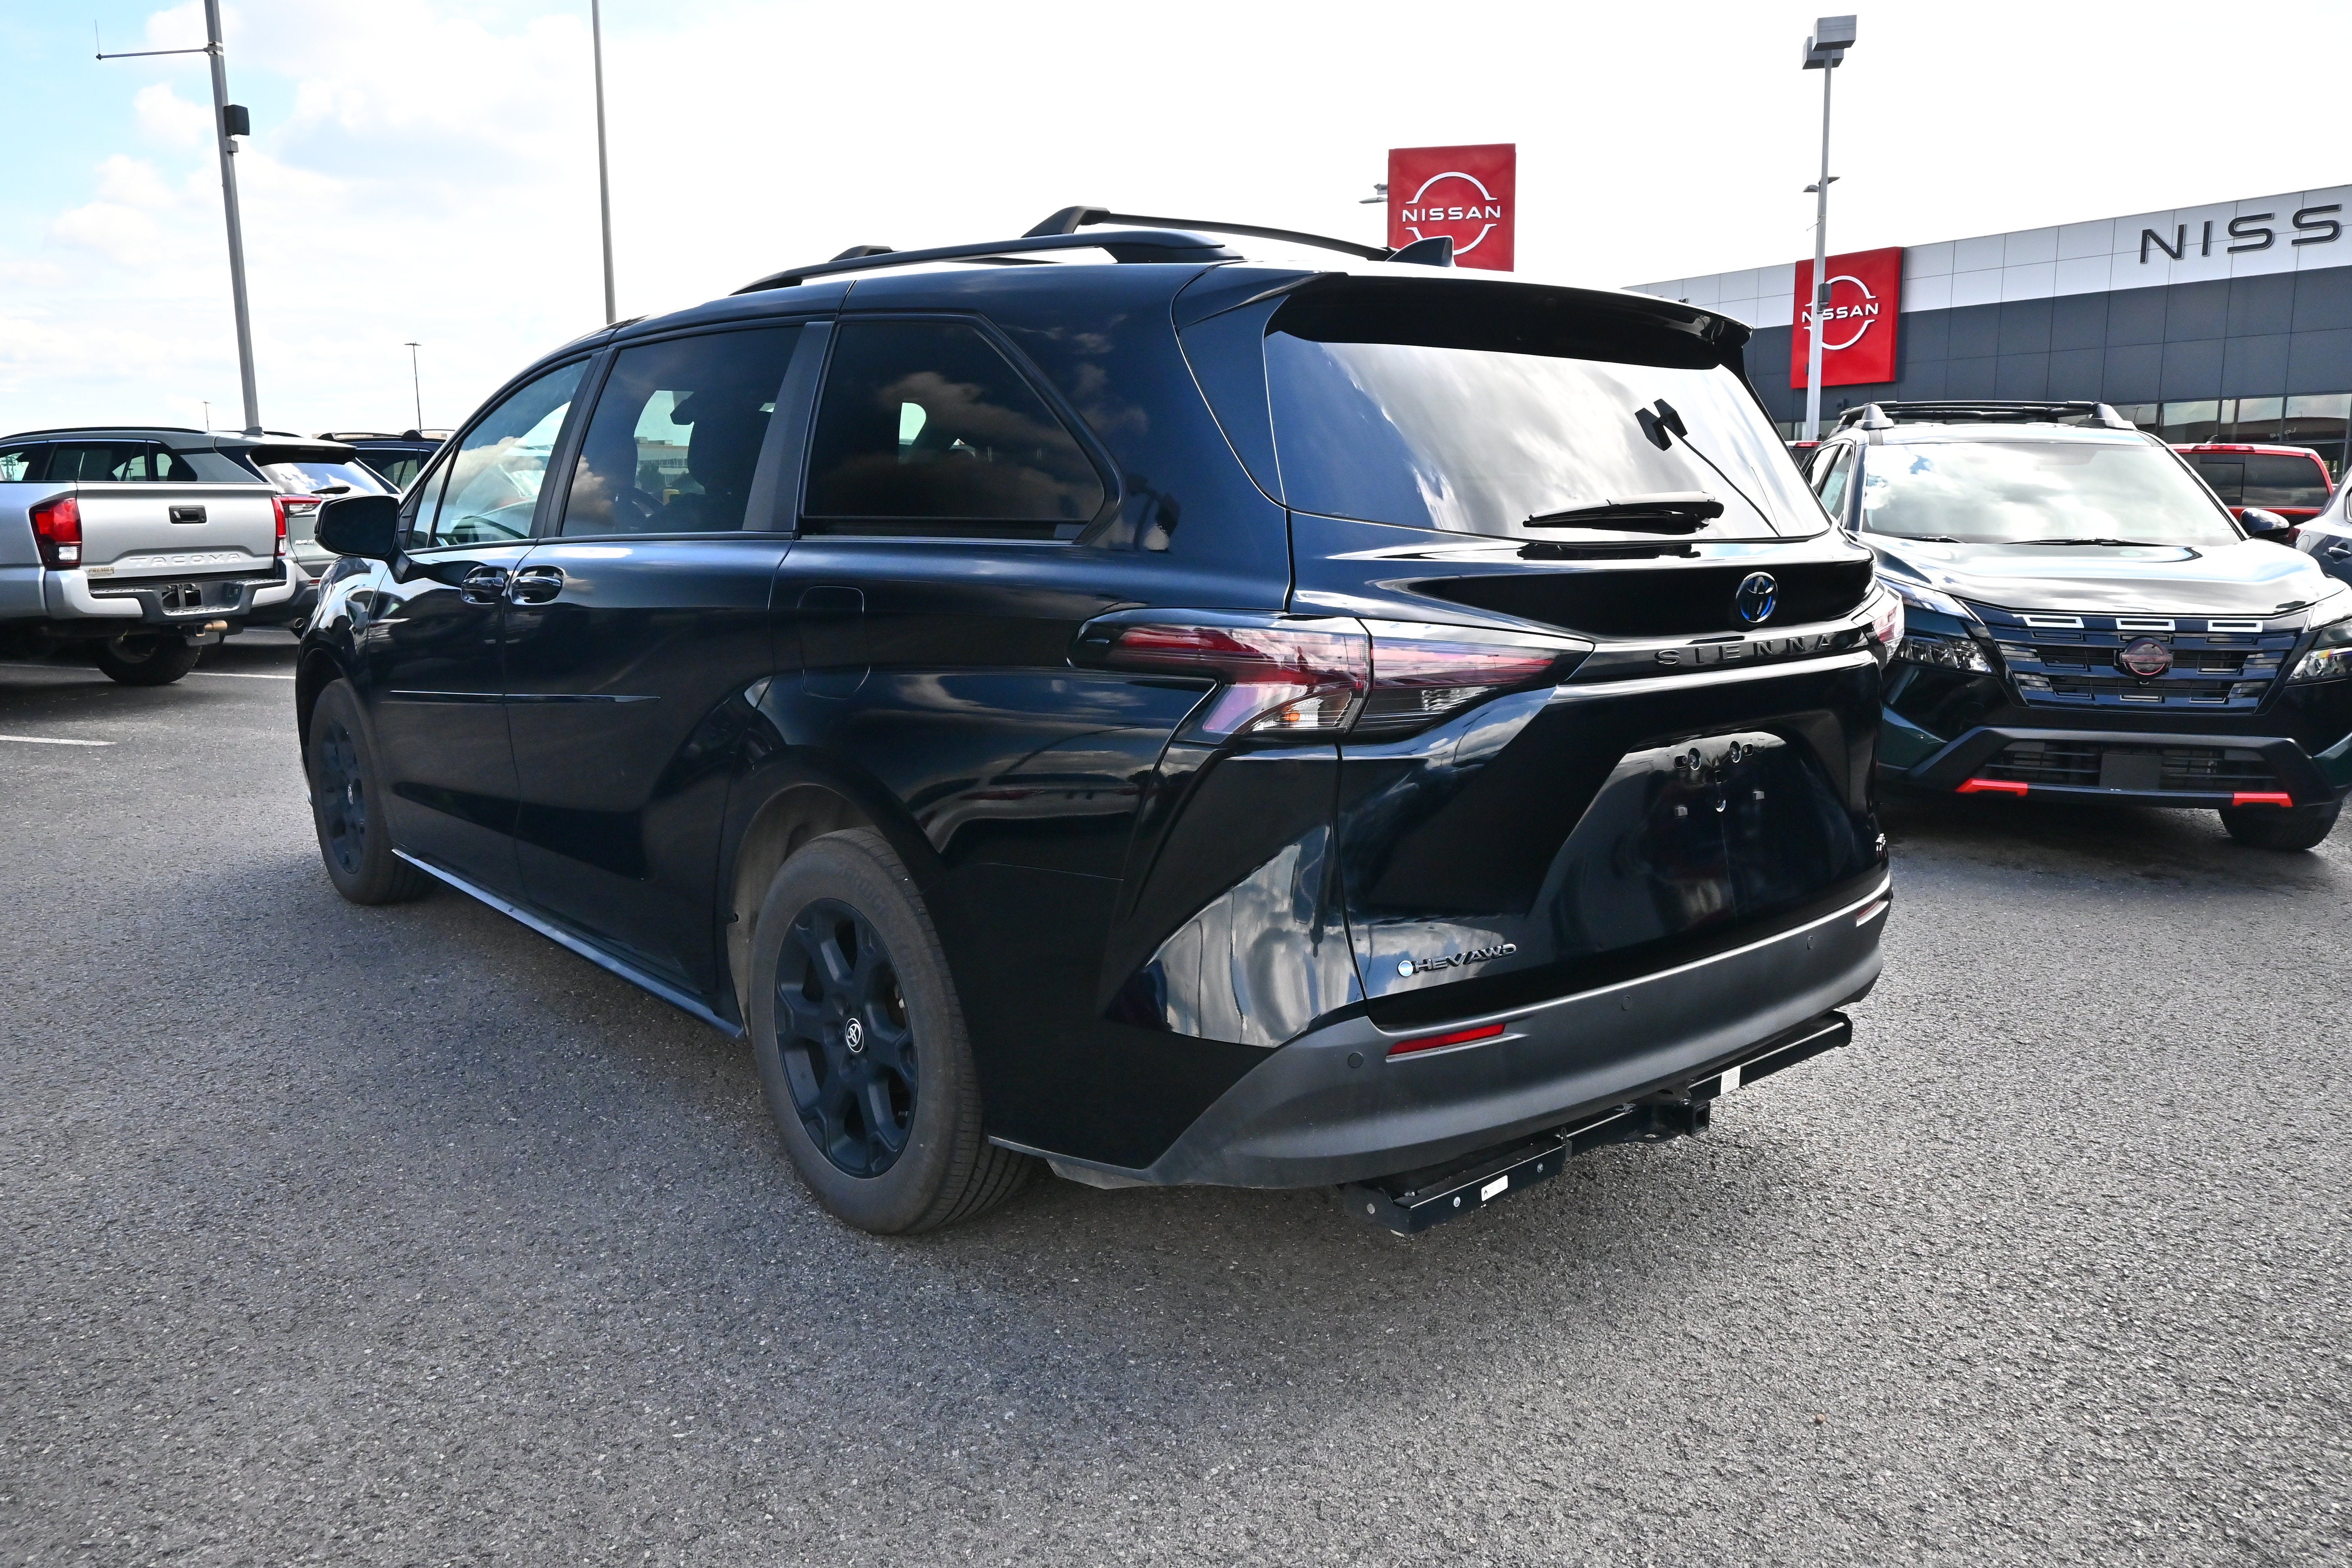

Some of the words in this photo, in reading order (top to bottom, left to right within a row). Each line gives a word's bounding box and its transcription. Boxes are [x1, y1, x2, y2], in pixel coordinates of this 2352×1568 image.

[1402, 205, 1501, 222] NISSAN
[1802, 302, 1879, 323] NSSAN
[129, 553, 241, 567] TACOMA
[1655, 634, 1832, 666] SIENNA
